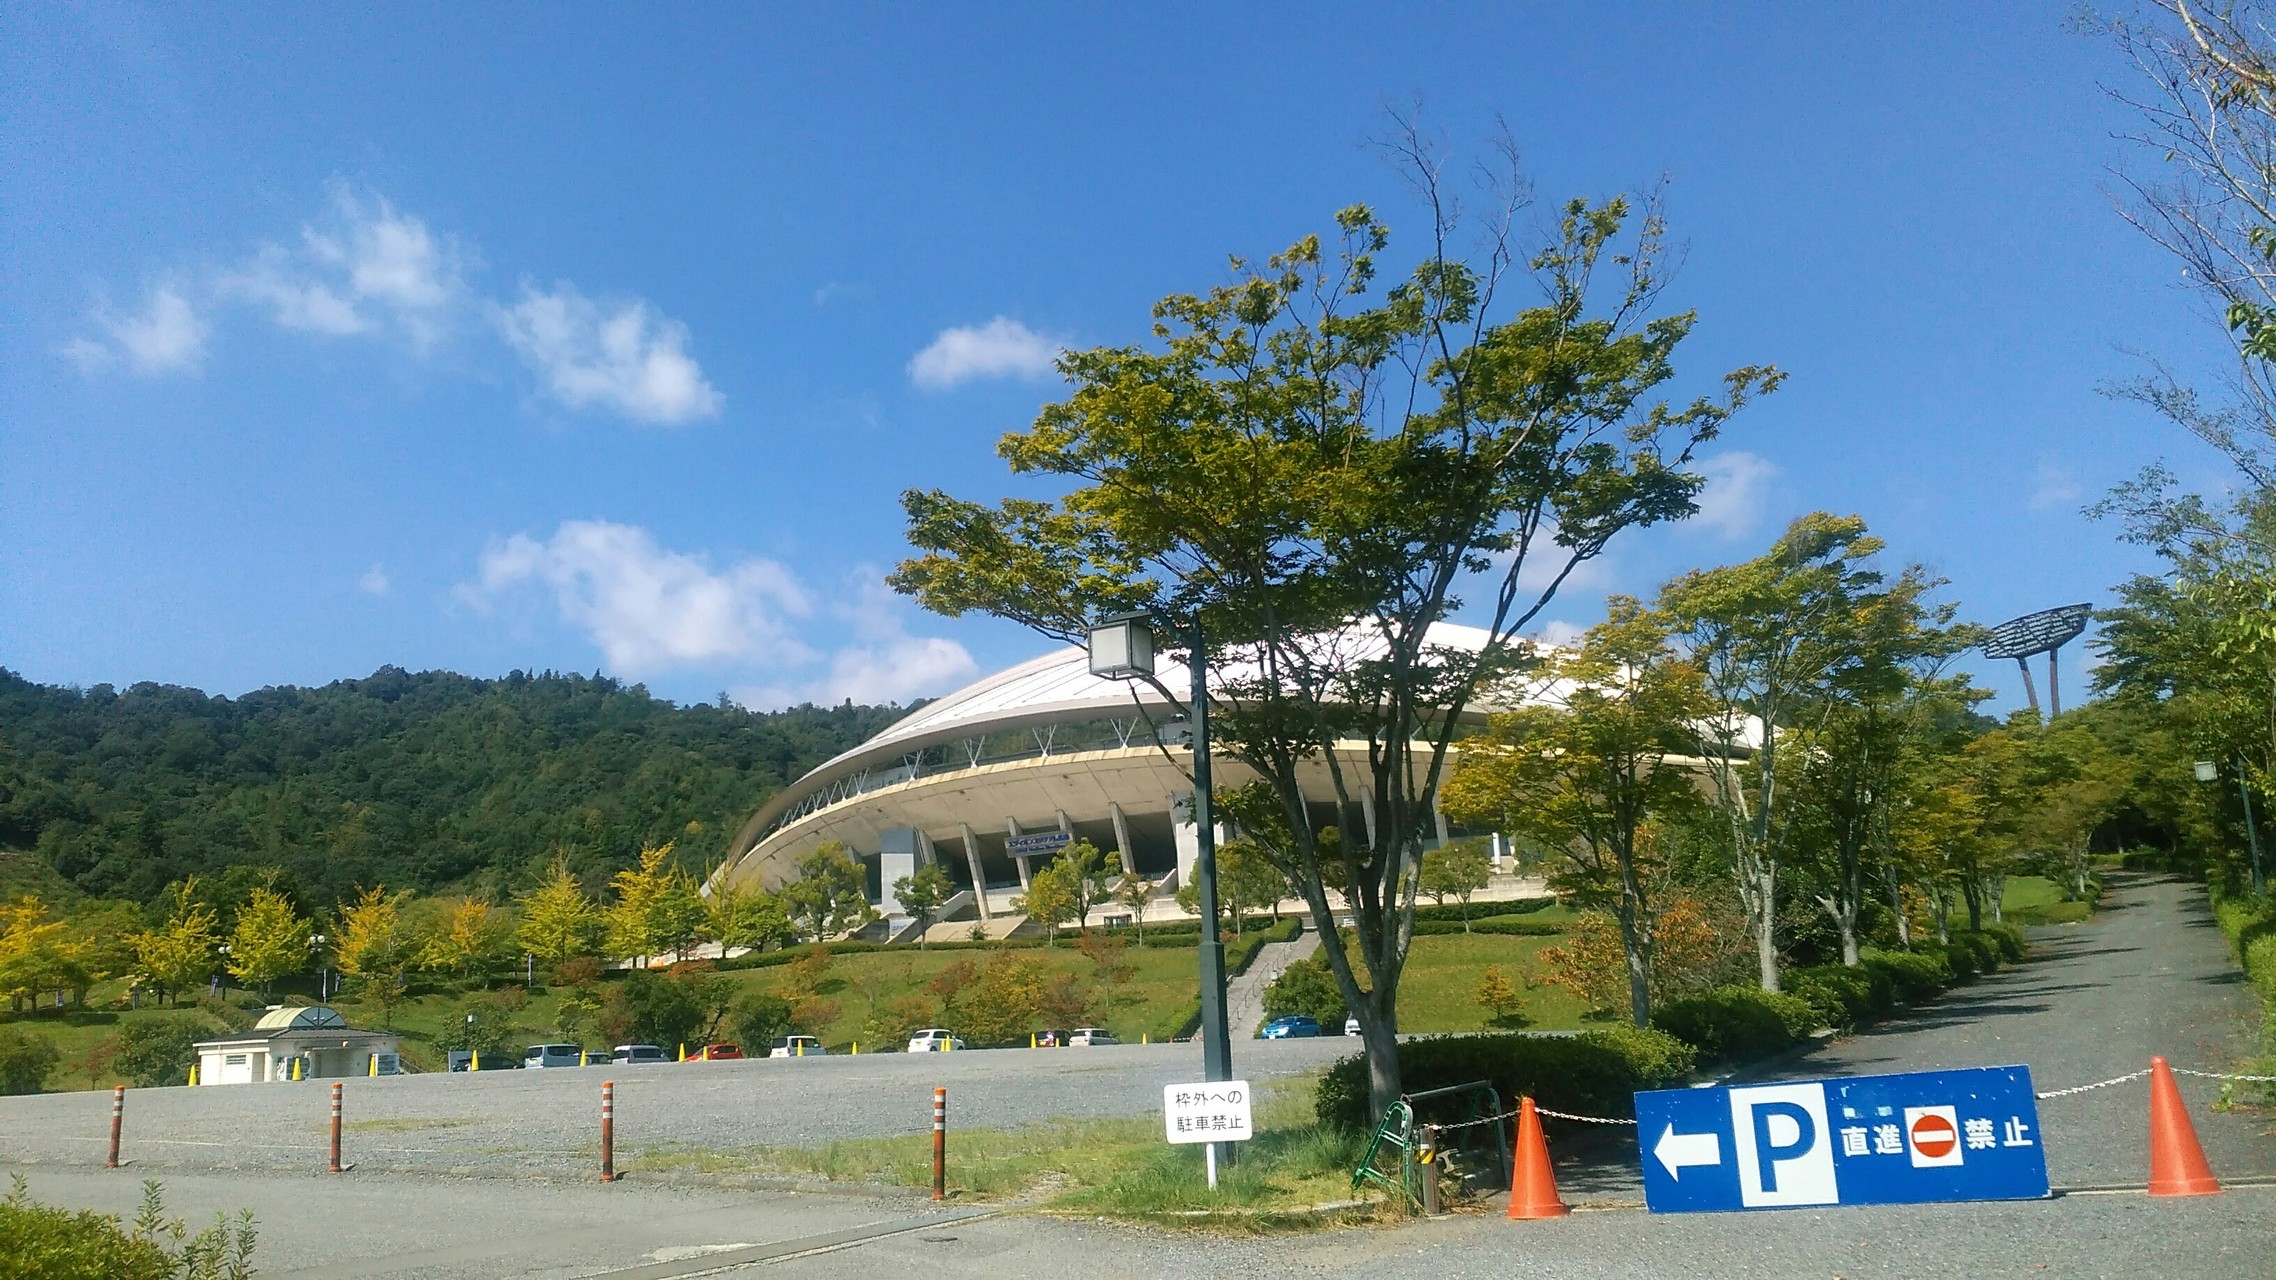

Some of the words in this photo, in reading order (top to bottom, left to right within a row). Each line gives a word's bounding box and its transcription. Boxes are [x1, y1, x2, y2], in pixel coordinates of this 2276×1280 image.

[1175, 1090, 1243, 1107] 枠外への
[1176, 1114, 1244, 1133] 駐車禁止
[1840, 1124, 1904, 1158] 直進
[1964, 1116, 2034, 1151] 禁止
[1750, 1101, 1816, 1193] P
